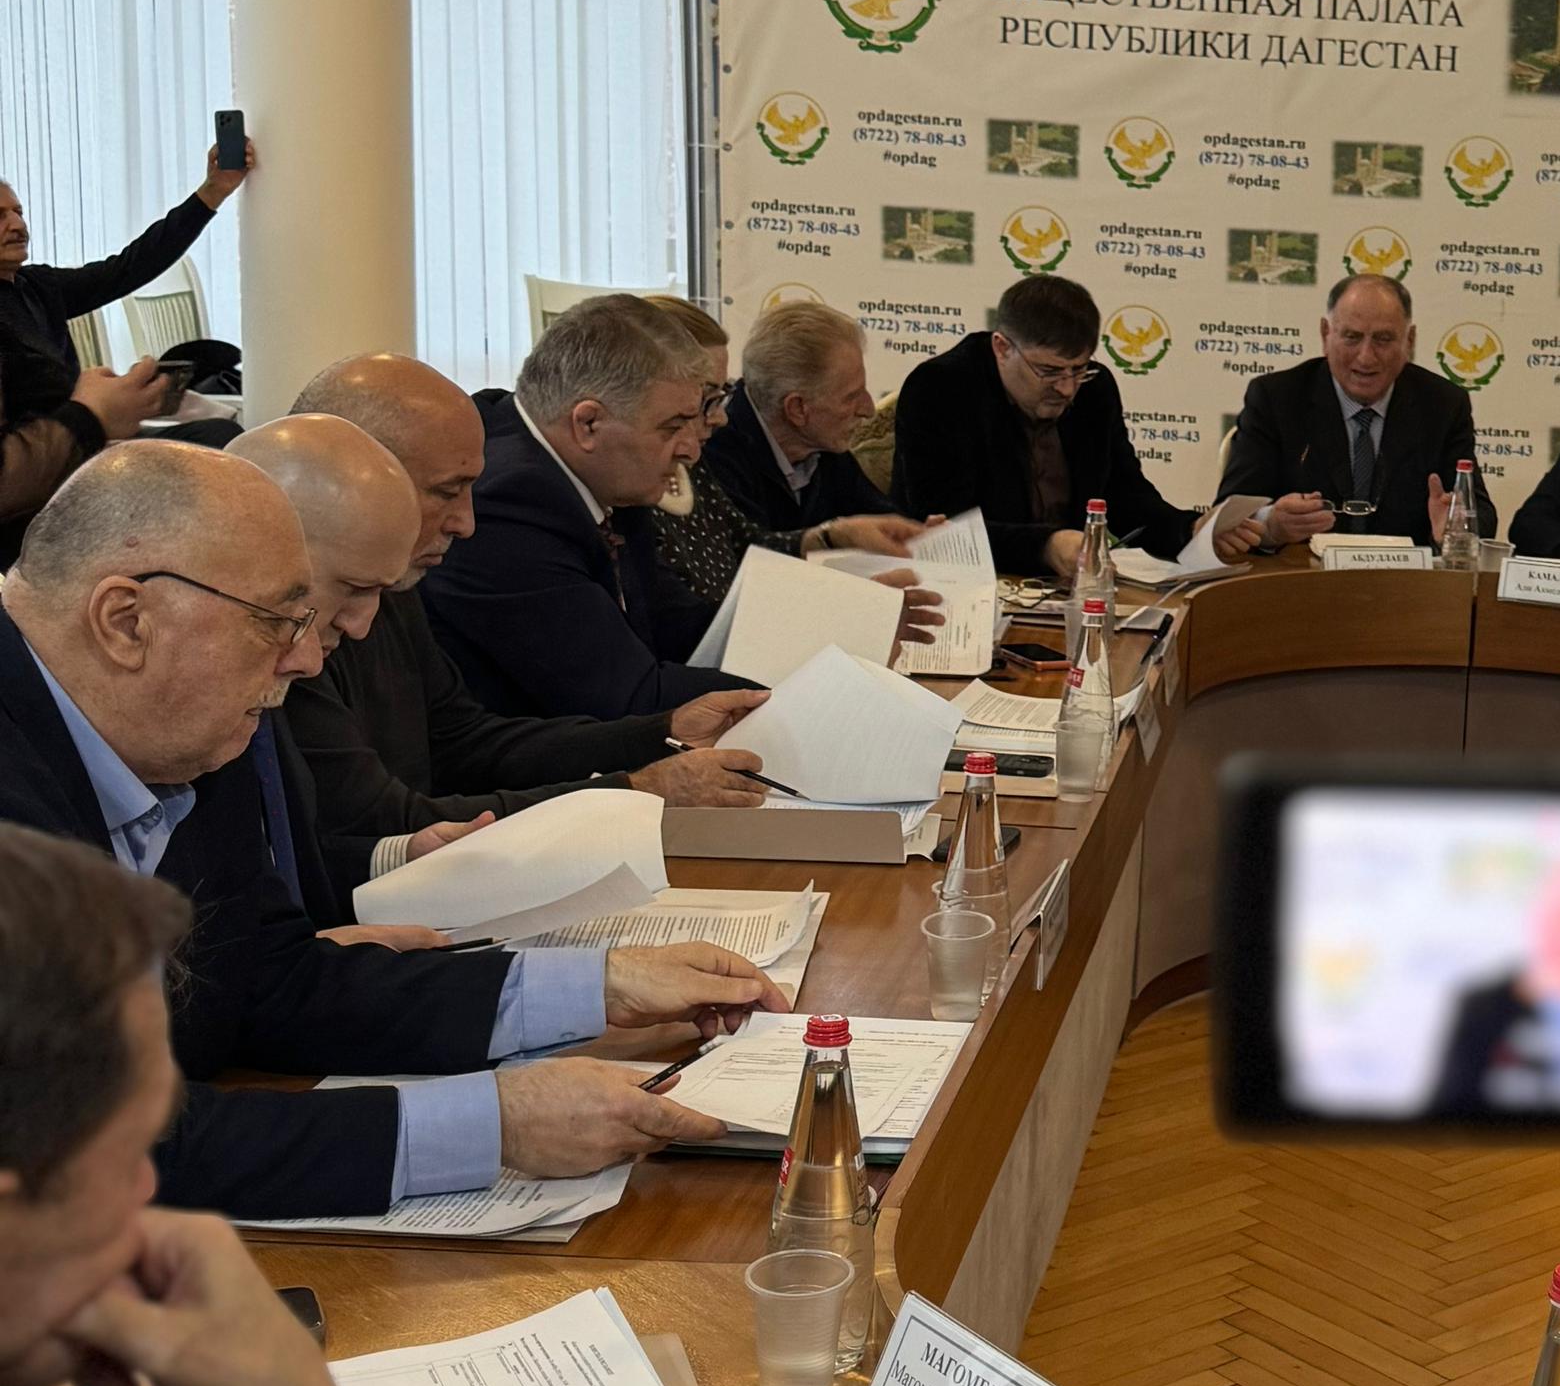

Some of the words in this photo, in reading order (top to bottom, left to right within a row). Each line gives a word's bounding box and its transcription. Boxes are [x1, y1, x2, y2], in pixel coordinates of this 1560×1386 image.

[1000, 16, 1251, 61] РЕСПУБЛИКИ
[1260, 34, 1458, 73] ДАГЕСТАН
[857, 109, 962, 127] opdagestan.ru
[853, 127, 899, 145] (8722)
[903, 130, 966, 147] 78-08-43
[1203, 133, 1306, 150] opdagestan.ru
[883, 149, 937, 168] #opdag
[1199, 151, 1244, 169] (8722)
[1248, 153, 1309, 169] 78-08-43
[1227, 173, 1280, 191] #opdag
[750, 198, 855, 216] opdagestan.ru
[746, 216, 793, 235] (8722)
[797, 219, 860, 236] 78-08-43
[1100, 222, 1202, 239] opdagestan.ru
[777, 239, 831, 257] #opdag
[1095, 240, 1141, 257] (8722)
[1144, 243, 1206, 259] 78-08-43
[1440, 241, 1540, 257] opdagestan.ru
[1124, 262, 1177, 279] #opdag
[1435, 258, 1480, 275] (8722)
[1483, 261, 1543, 276] 78-08-43
[1463, 280, 1515, 297] #opdag
[858, 299, 961, 317] opdagestan.ru
[857, 317, 900, 334] 8722)
[903, 320, 966, 336] 78-08-43
[1199, 321, 1300, 337] opdagestan.ru
[883, 338, 937, 356] #opdag
[1195, 339, 1239, 356] (8722)
[1243, 341, 1304, 356] 78-08-43
[1223, 359, 1275, 376] #opdag
[1140, 427, 1200, 443] 78-08-43
